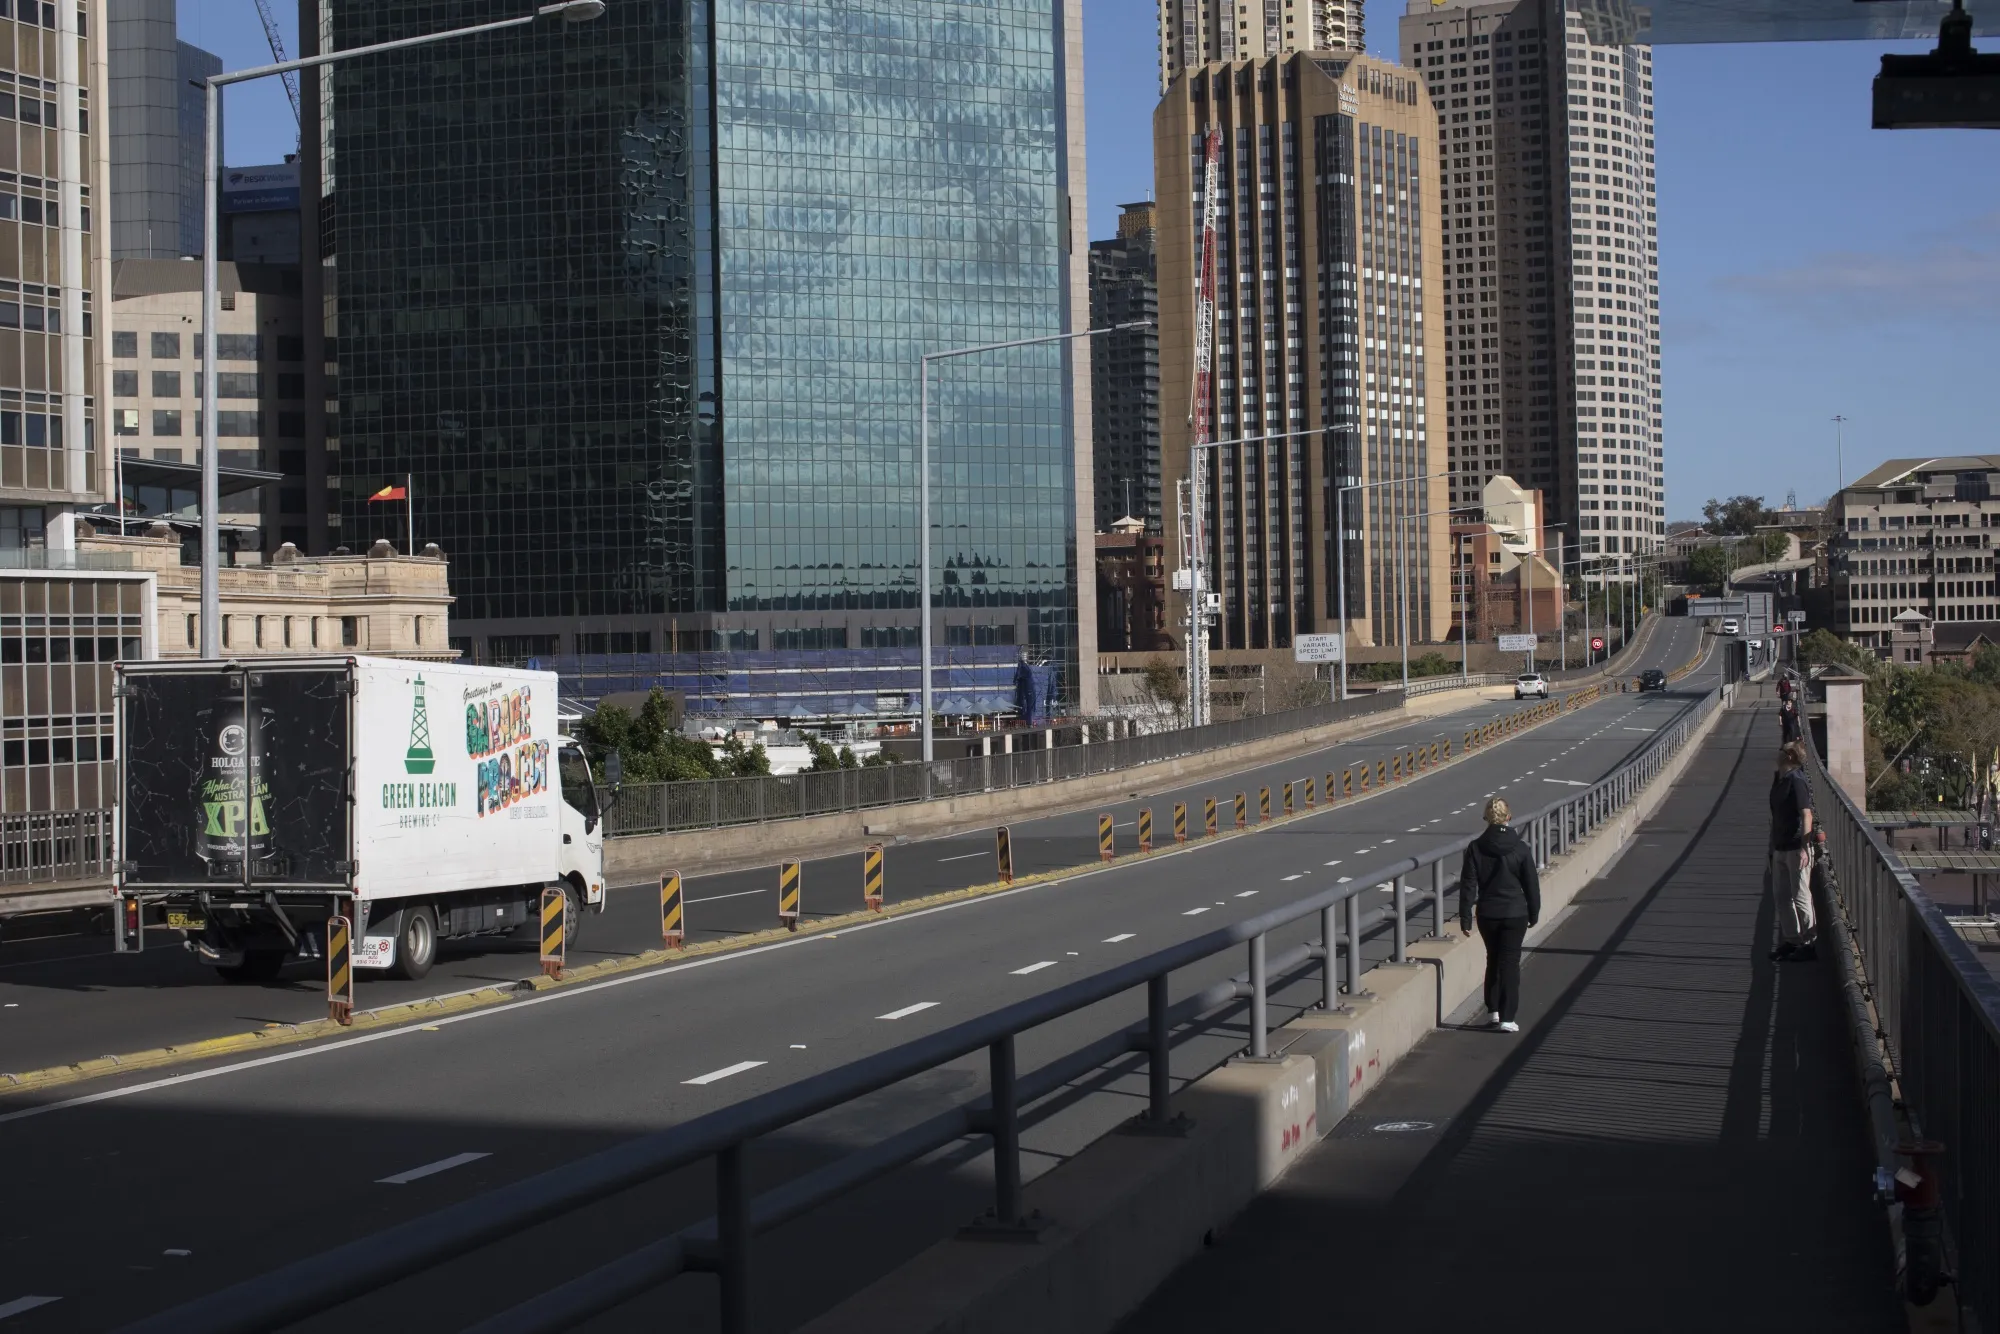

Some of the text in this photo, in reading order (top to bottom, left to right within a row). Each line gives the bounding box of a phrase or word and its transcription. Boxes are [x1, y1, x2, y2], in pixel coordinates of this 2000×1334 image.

[463, 681, 503, 704] Greetings from
[466, 685, 531, 759] GARAGE
[211, 756, 260, 767] HOLGATE
[201, 779, 230, 798] Alpha
[477, 738, 550, 818] PROJECT
[382, 783, 457, 808] GREEN BEACON
[203, 796, 270, 837] XPA
[399, 814, 430, 828] BREWING
[1981, 829, 1988, 838] 6
